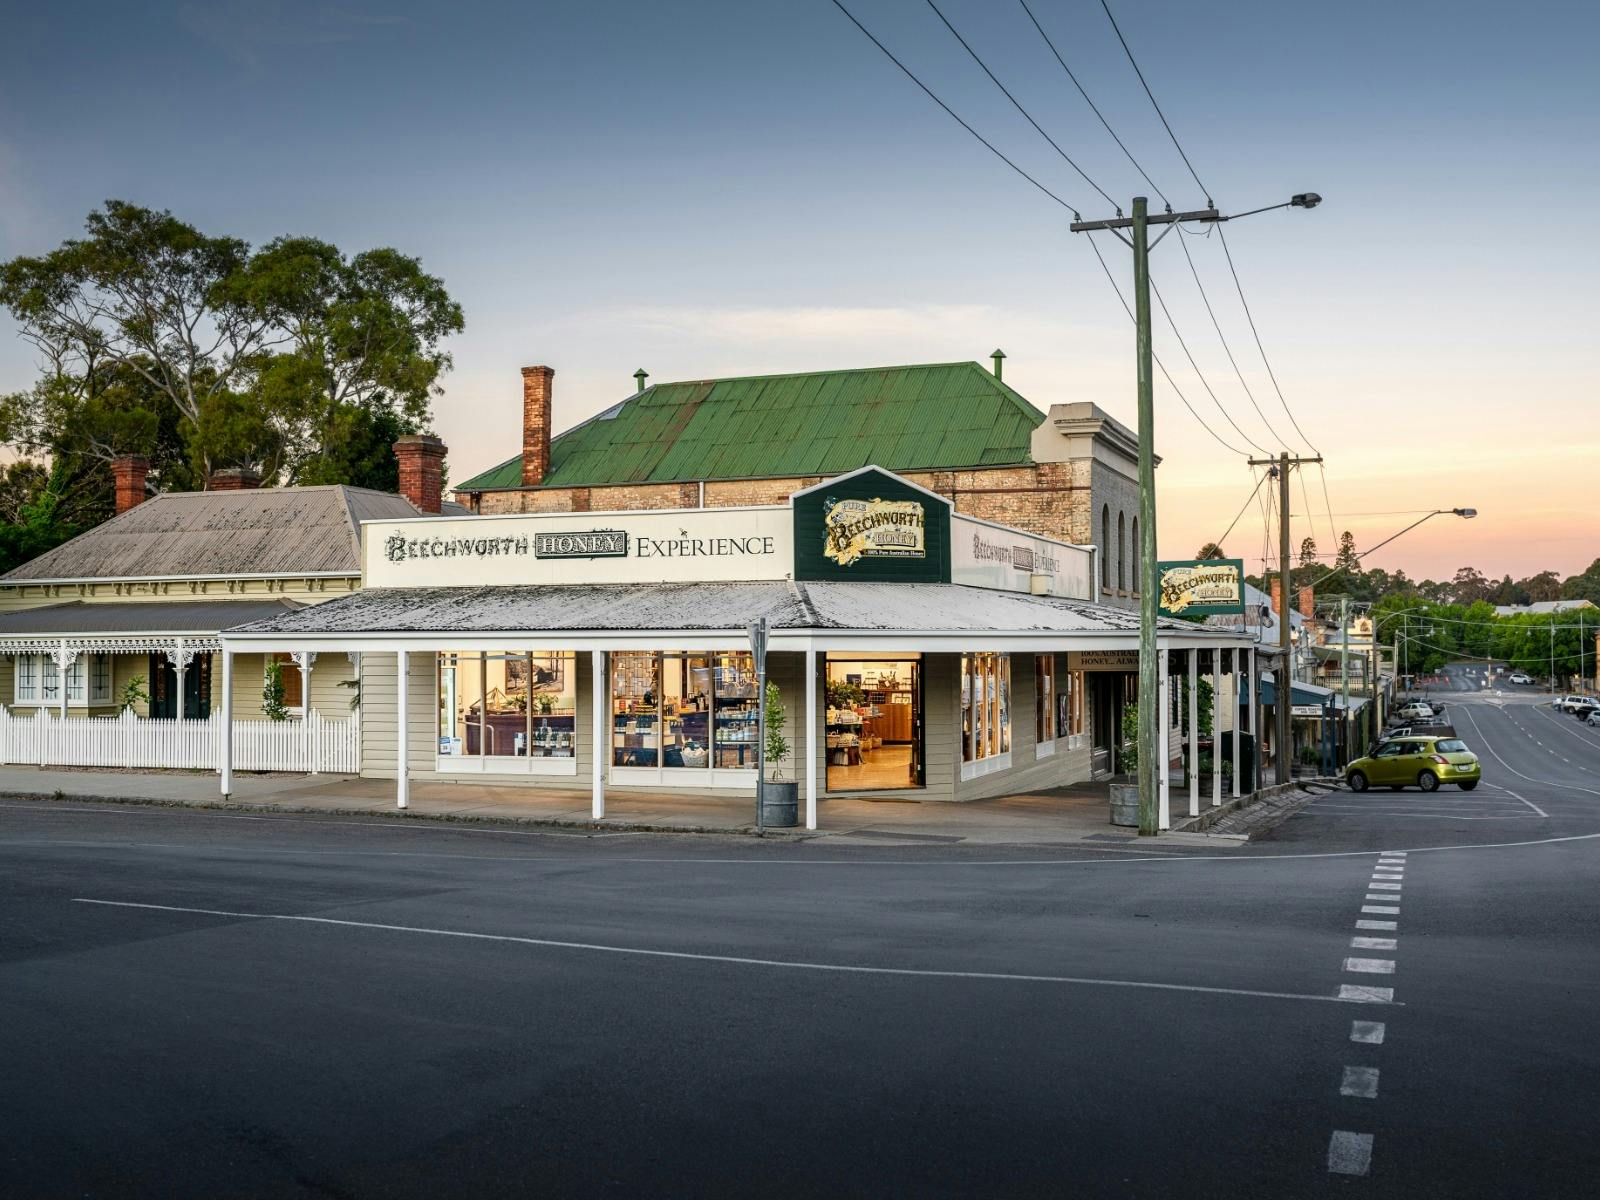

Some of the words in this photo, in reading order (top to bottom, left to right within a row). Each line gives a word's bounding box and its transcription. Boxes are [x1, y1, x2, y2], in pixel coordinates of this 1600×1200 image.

[843, 502, 867, 511] PURE
[829, 512, 925, 552] BEECHWORTH
[876, 532, 914, 545] HONEY
[386, 532, 528, 562] BEECHWORTH
[542, 536, 619, 553] HONEY
[635, 536, 775, 558] EXPERIENCE
[1163, 573, 1240, 604] BEECHWORTH
[1116, 657, 1139, 665] ALWA
